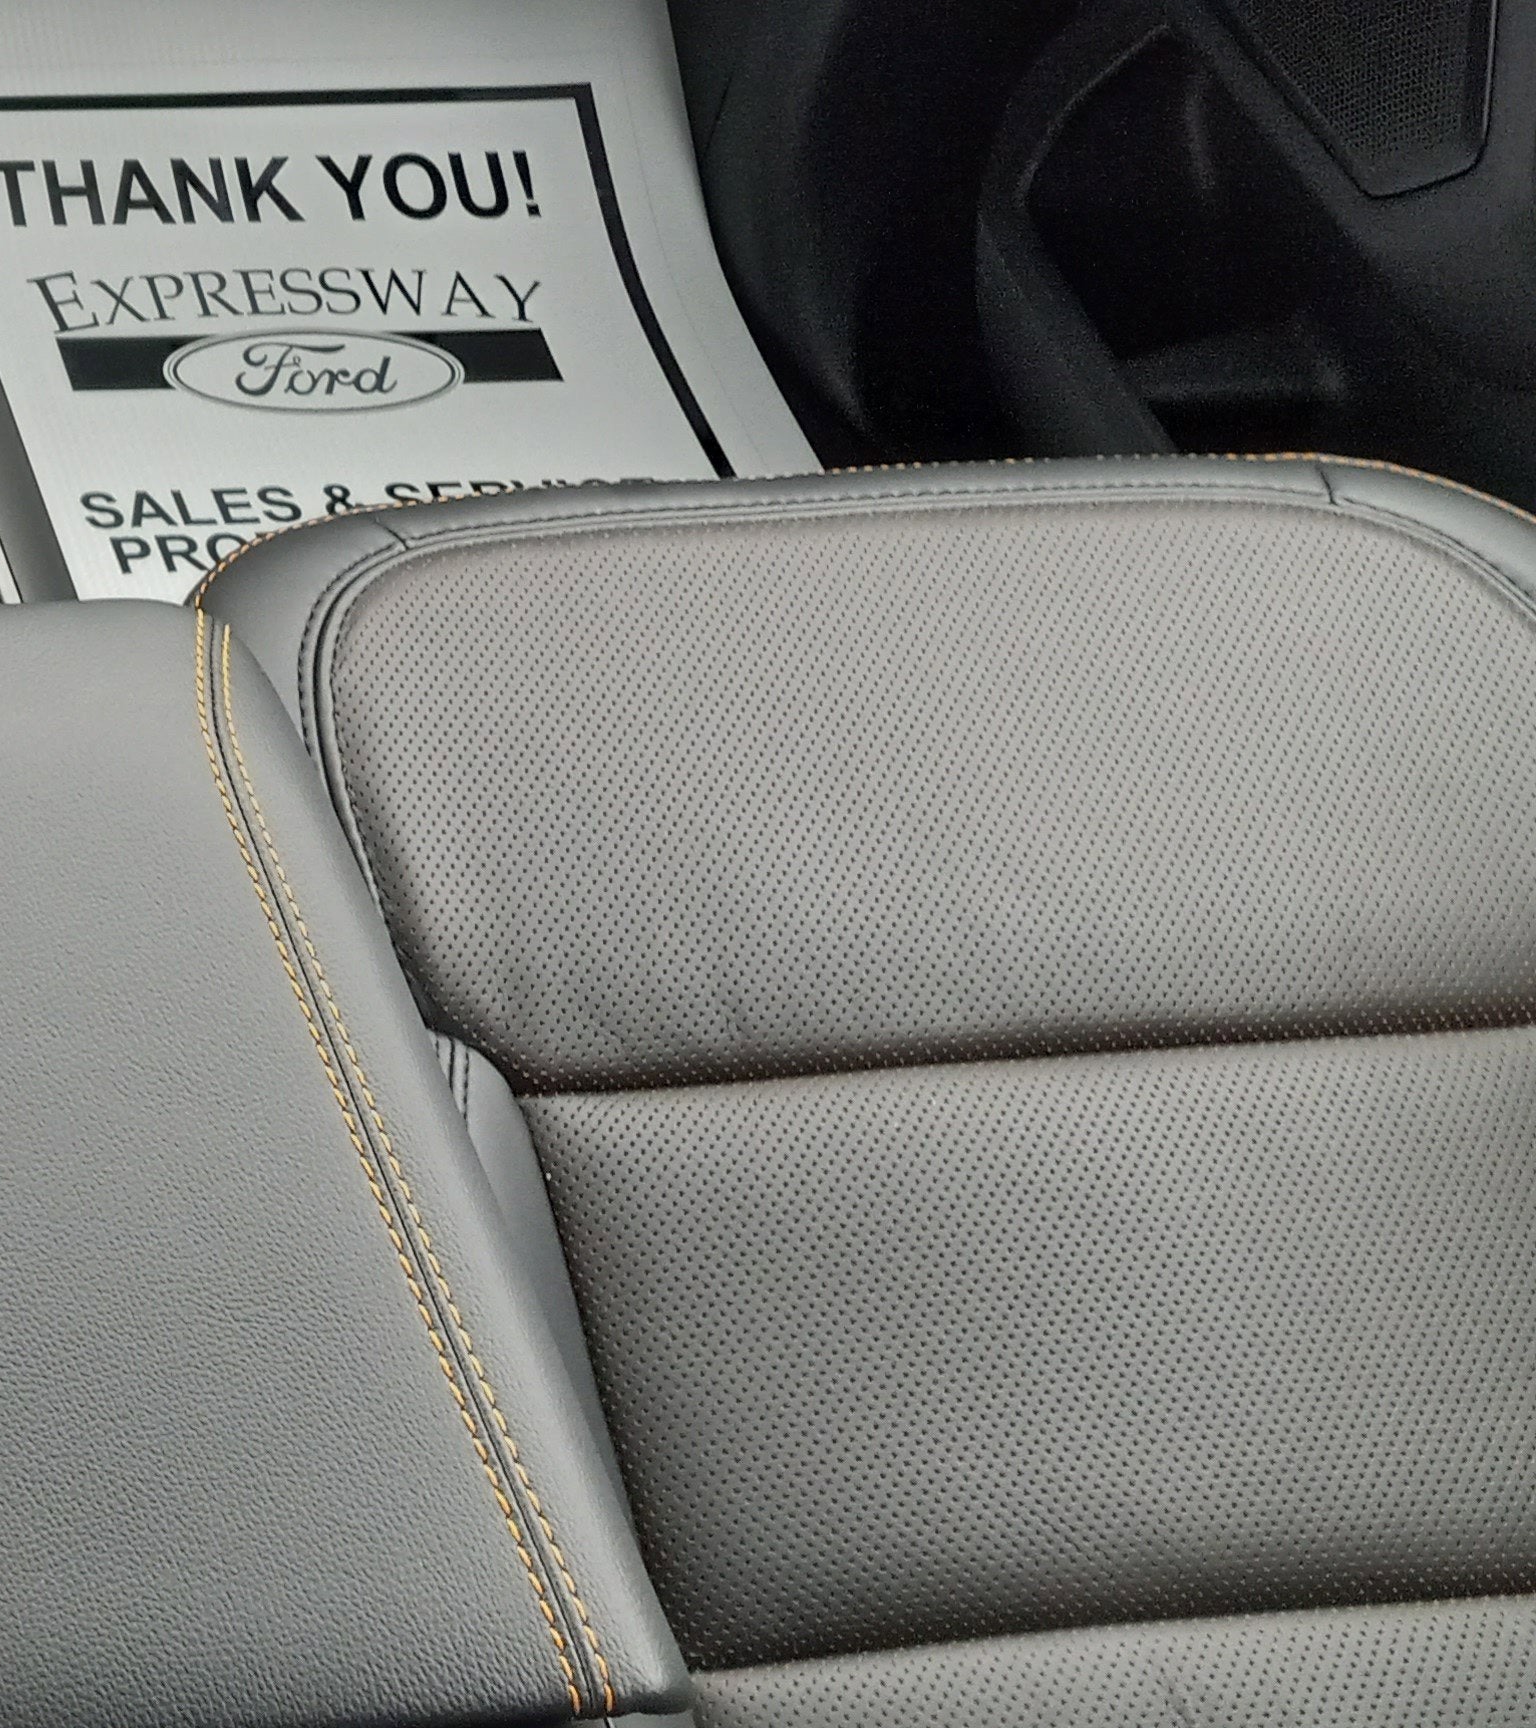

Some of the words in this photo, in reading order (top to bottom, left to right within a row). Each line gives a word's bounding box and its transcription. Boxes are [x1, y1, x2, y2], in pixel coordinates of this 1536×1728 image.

[314, 148, 544, 226] YOU!
[234, 340, 399, 398] Ford
[79, 483, 303, 531] SALES
